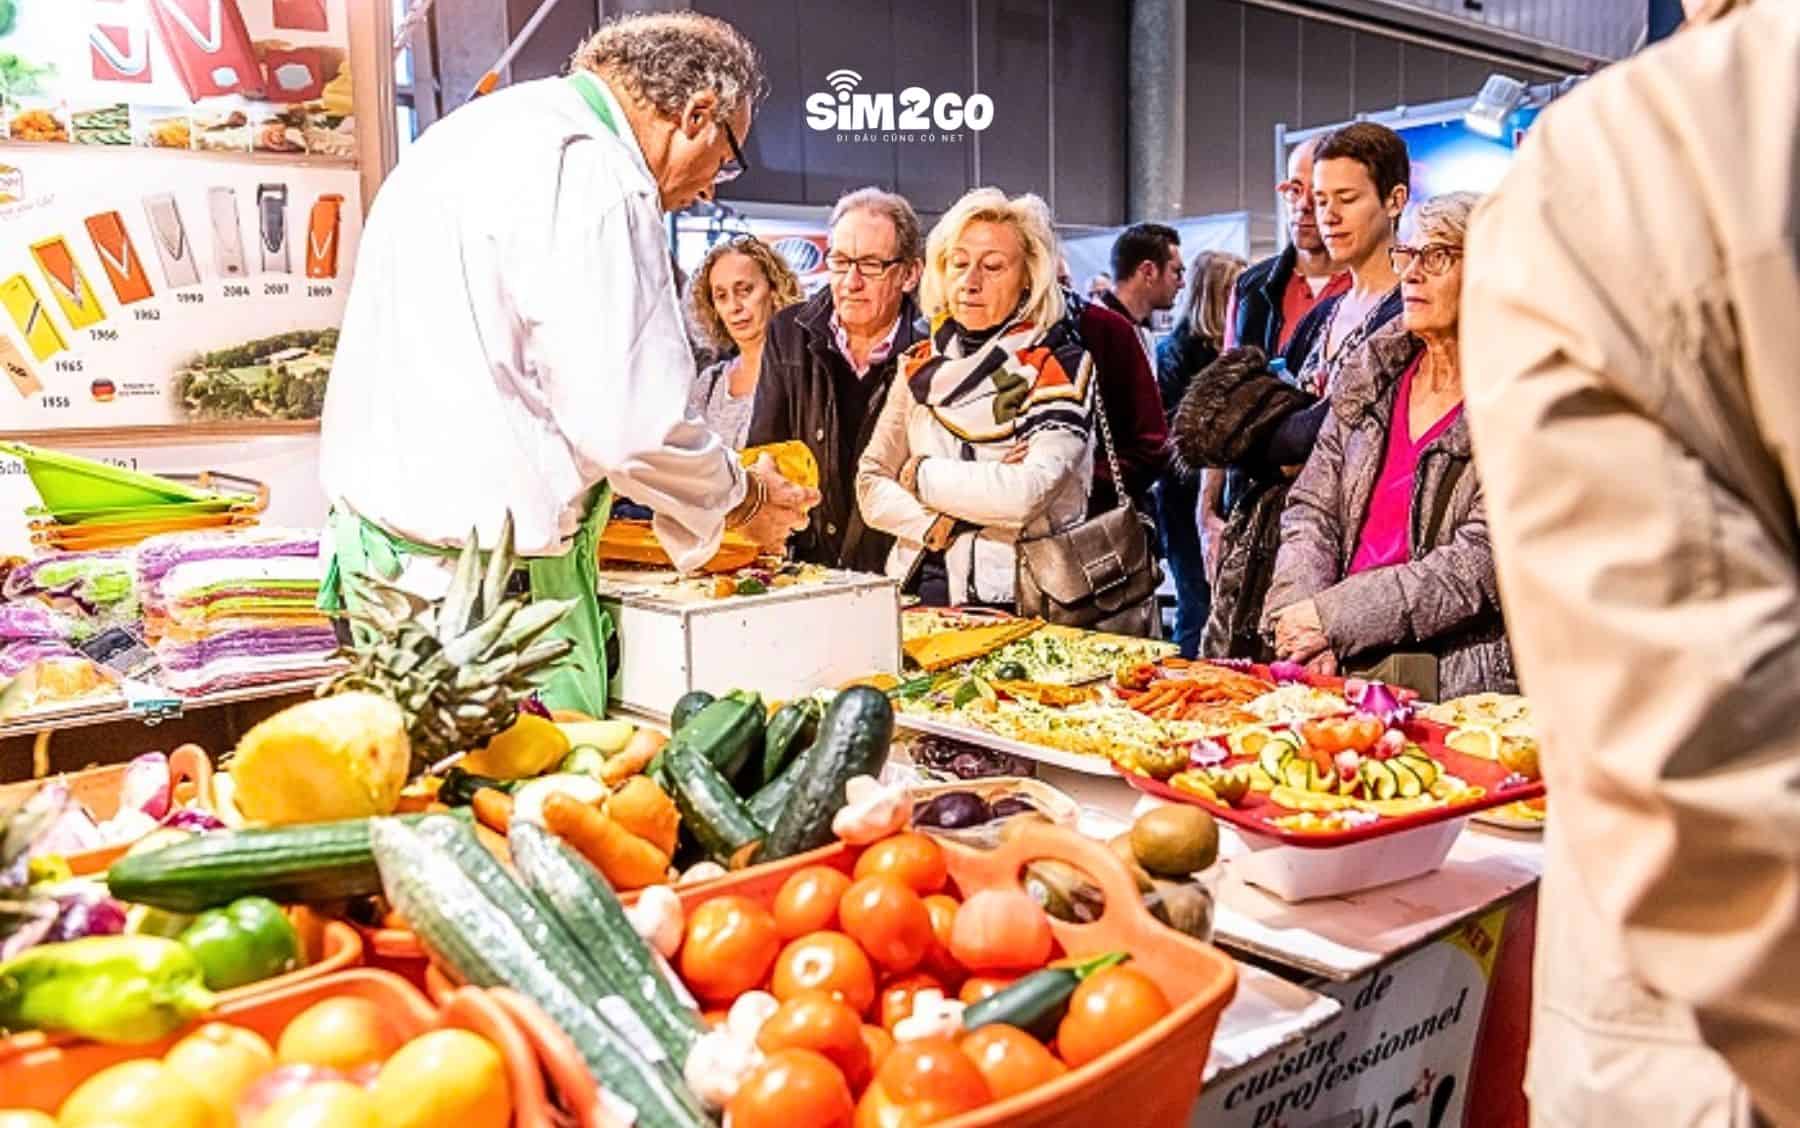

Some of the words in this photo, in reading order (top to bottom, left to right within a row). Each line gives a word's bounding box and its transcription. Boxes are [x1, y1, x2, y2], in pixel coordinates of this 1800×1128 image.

[55, 360, 83, 373] 1965
[1353, 971, 1393, 1012] de
[1223, 1031, 1347, 1111] cuisine
[1250, 987, 1469, 1128] professionnel
